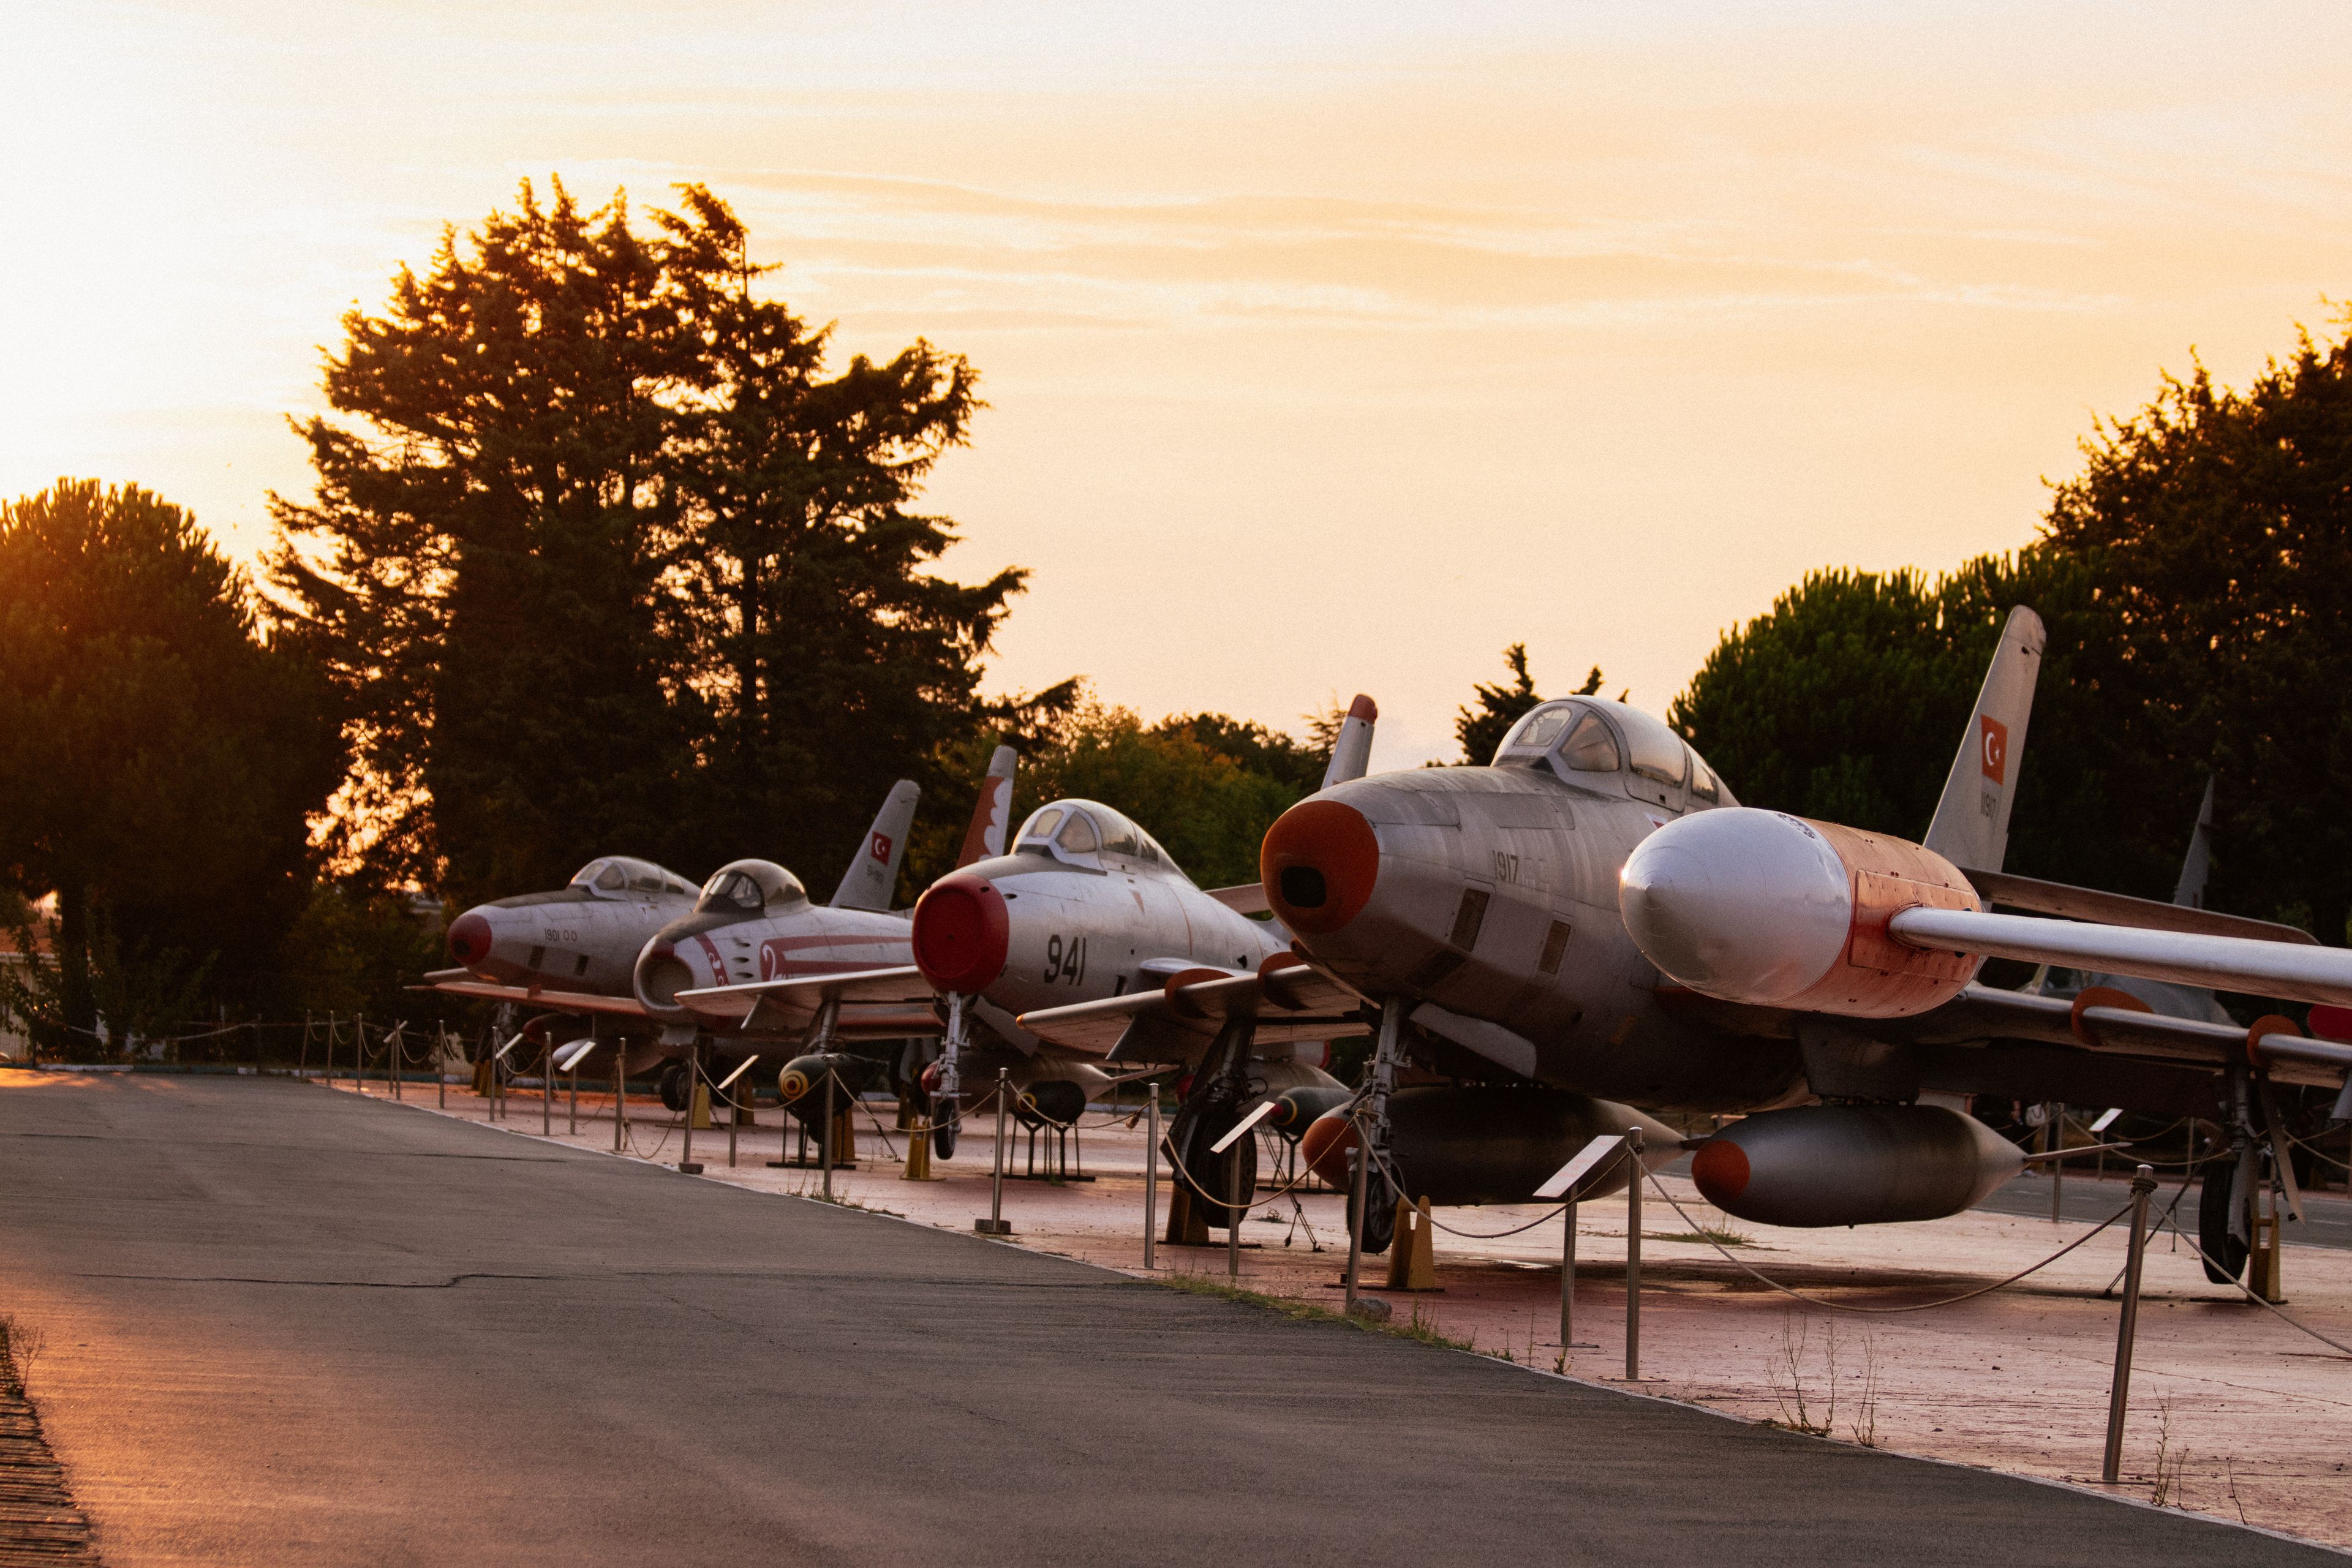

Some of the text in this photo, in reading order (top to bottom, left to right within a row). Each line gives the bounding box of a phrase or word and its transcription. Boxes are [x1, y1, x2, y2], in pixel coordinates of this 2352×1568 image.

[1492, 850, 1519, 884] 1917
[544, 928, 560, 942] 1901
[1044, 934, 1087, 986] 941
